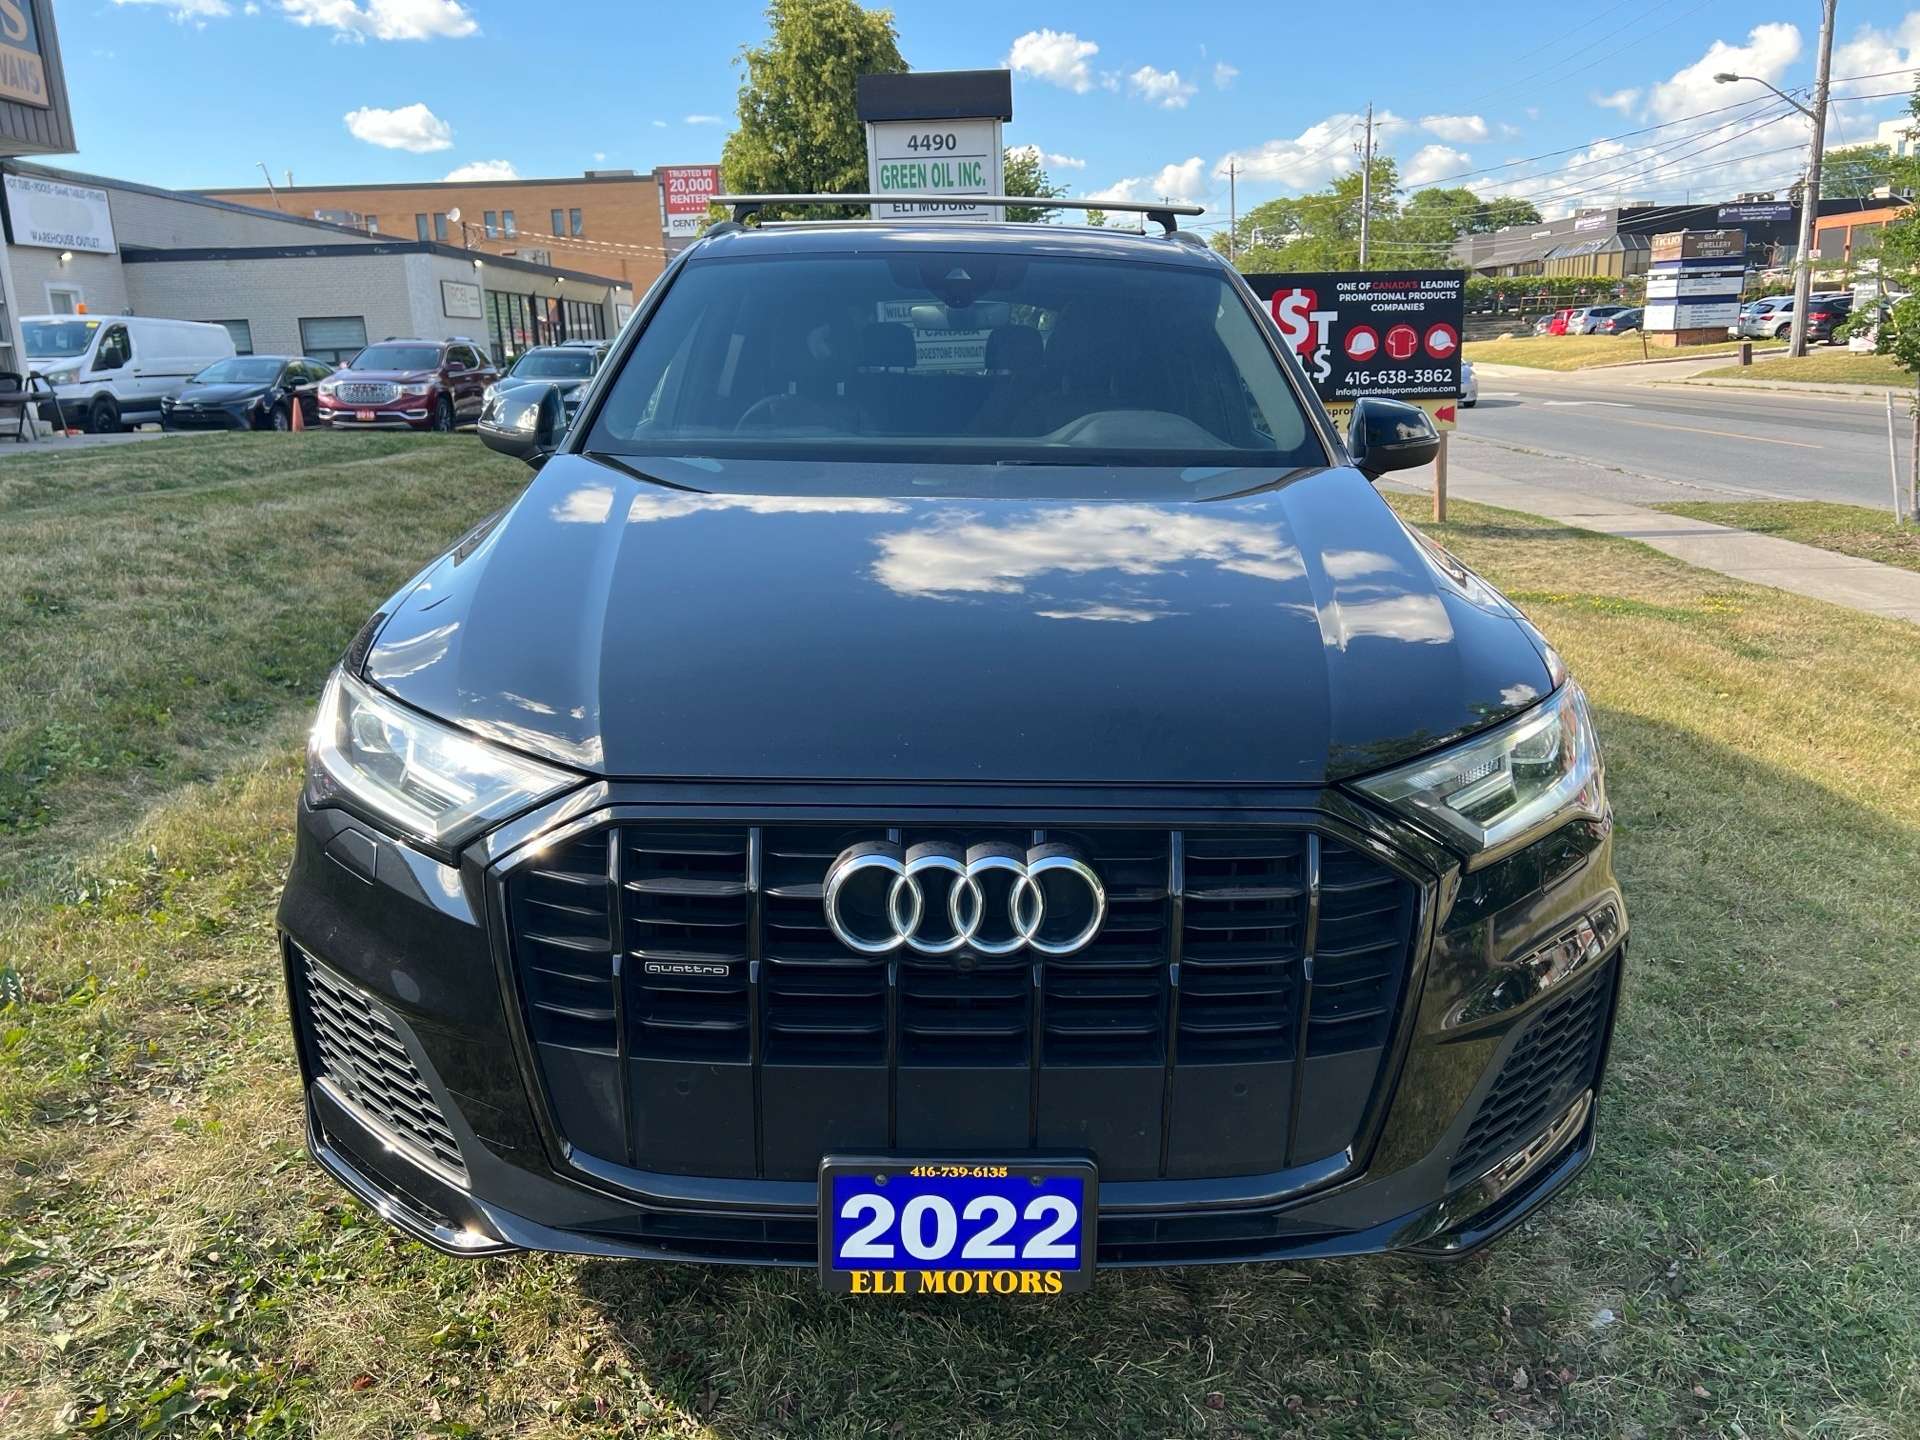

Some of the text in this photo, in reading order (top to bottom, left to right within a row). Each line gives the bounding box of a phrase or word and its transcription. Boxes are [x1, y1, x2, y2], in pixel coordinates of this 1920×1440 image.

[907, 133, 957, 151] 4490
[668, 168, 713, 178] TRUSTED BY
[880, 160, 986, 189] GREEN OIL INC.
[669, 178, 713, 194] 20,000
[670, 193, 712, 204] RENTER
[30, 230, 101, 249] WAREHOUSE OUTLET
[1336, 280, 1460, 291] ONE OF CANADA'S LEADING
[1339, 291, 1457, 302] PROMOTIONAL PRODUCTS
[1370, 302, 1425, 312] COMPANIES
[1345, 368, 1452, 385] 416-638-3862
[1335, 385, 1457, 397] info@justdealspromotions.com
[648, 965, 725, 974] quattro
[909, 1166, 1009, 1179] 416-739-6135
[839, 1193, 1079, 1261] 2022
[849, 1270, 1063, 1295] ELI MOTORS
